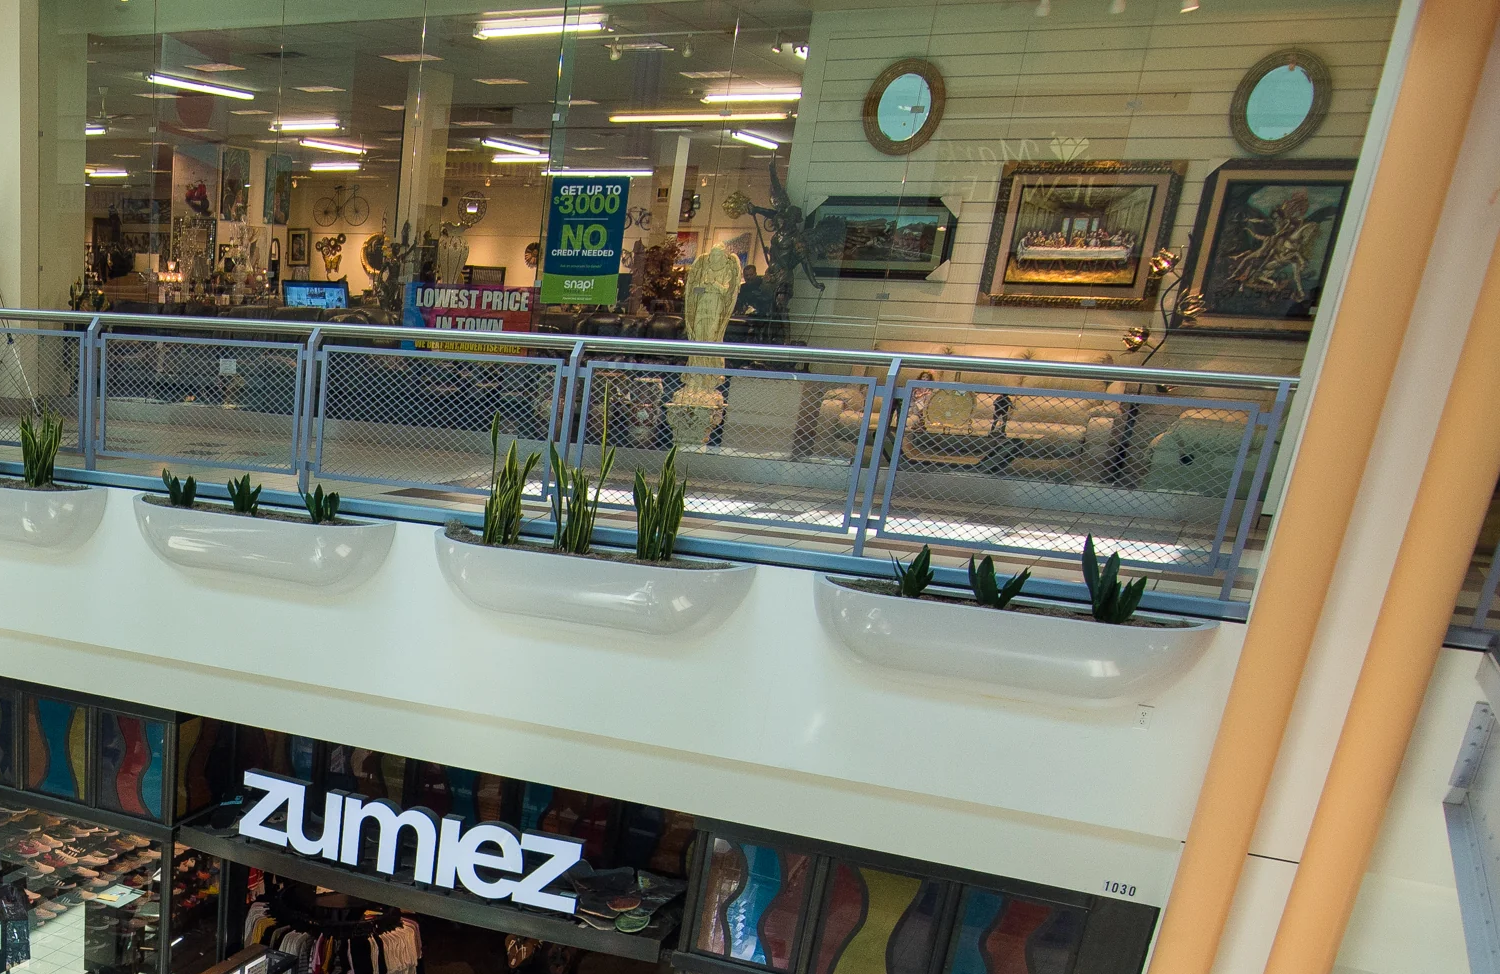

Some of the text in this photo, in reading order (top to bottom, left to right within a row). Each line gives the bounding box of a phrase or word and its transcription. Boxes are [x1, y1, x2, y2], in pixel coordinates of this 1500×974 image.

[560, 185, 622, 195] GET UP TO
[554, 194, 620, 216] $3,000
[561, 224, 607, 250] NO
[551, 249, 580, 257] CREDIT
[564, 279, 594, 291] snap!
[416, 288, 530, 312] LOWEST PRICE
[436, 316, 504, 332] IN TOWN
[499, 345, 521, 354] PRICE
[239, 770, 585, 914] zumiez
[1104, 880, 1136, 897] 1030
